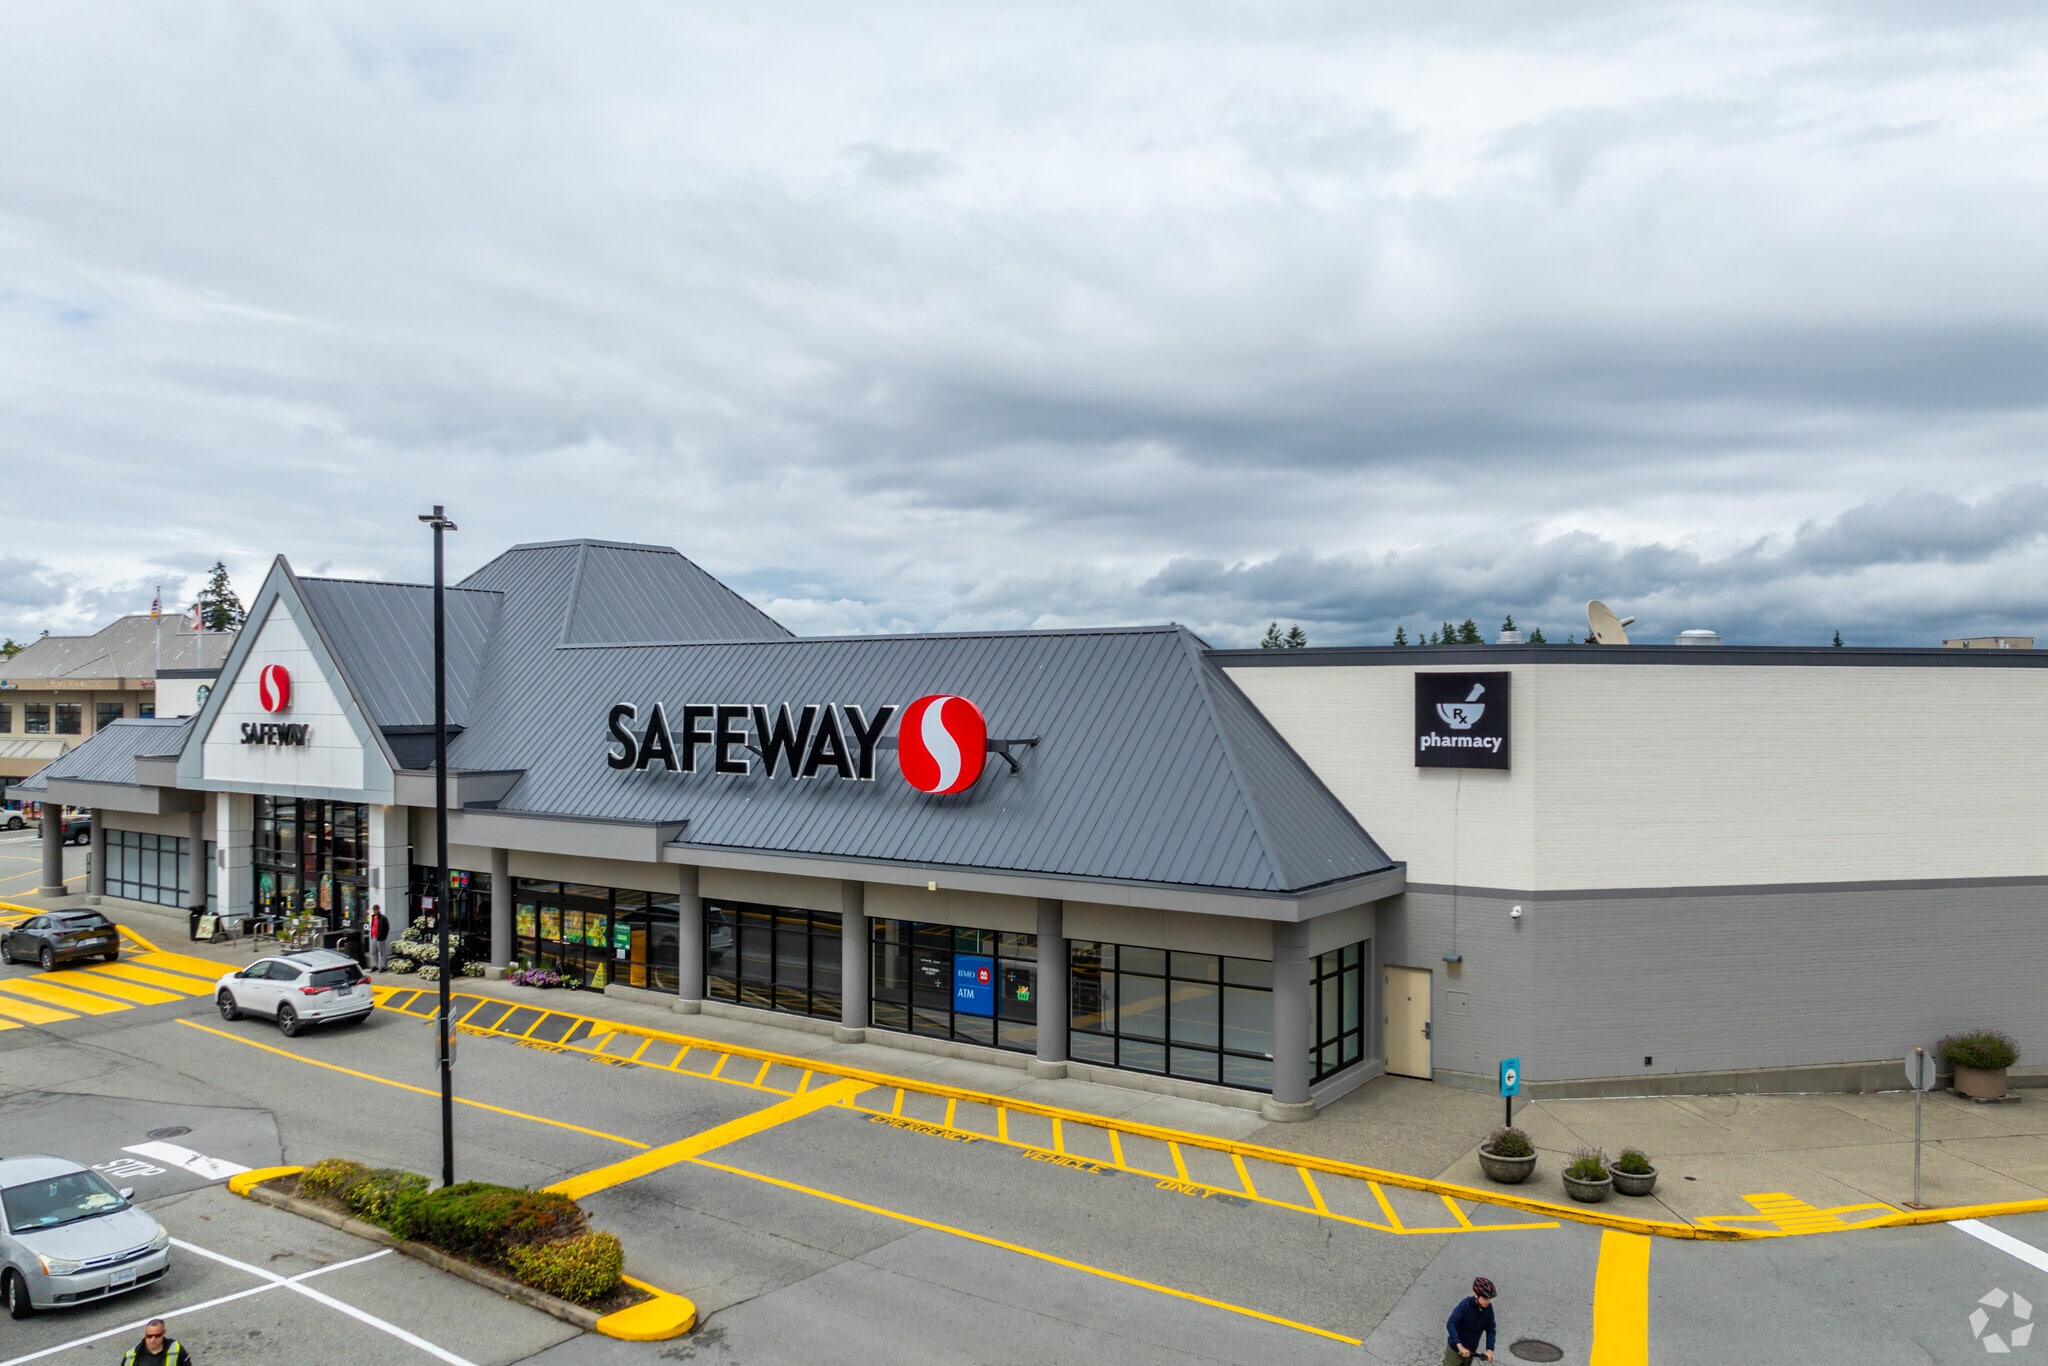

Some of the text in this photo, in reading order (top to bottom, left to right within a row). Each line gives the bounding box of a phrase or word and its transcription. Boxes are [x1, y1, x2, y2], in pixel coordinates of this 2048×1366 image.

[1453, 708, 1468, 724] Rx
[241, 722, 309, 746] SAFEWAY
[607, 701, 899, 781] SAFEWAY
[1420, 731, 1503, 753] pharmacy
[957, 969, 976, 979] BMO
[957, 988, 975, 999] ATM
[869, 1115, 1218, 1199] EMERGENCY VEHICLE ONLY
[91, 1158, 167, 1178] STOP
